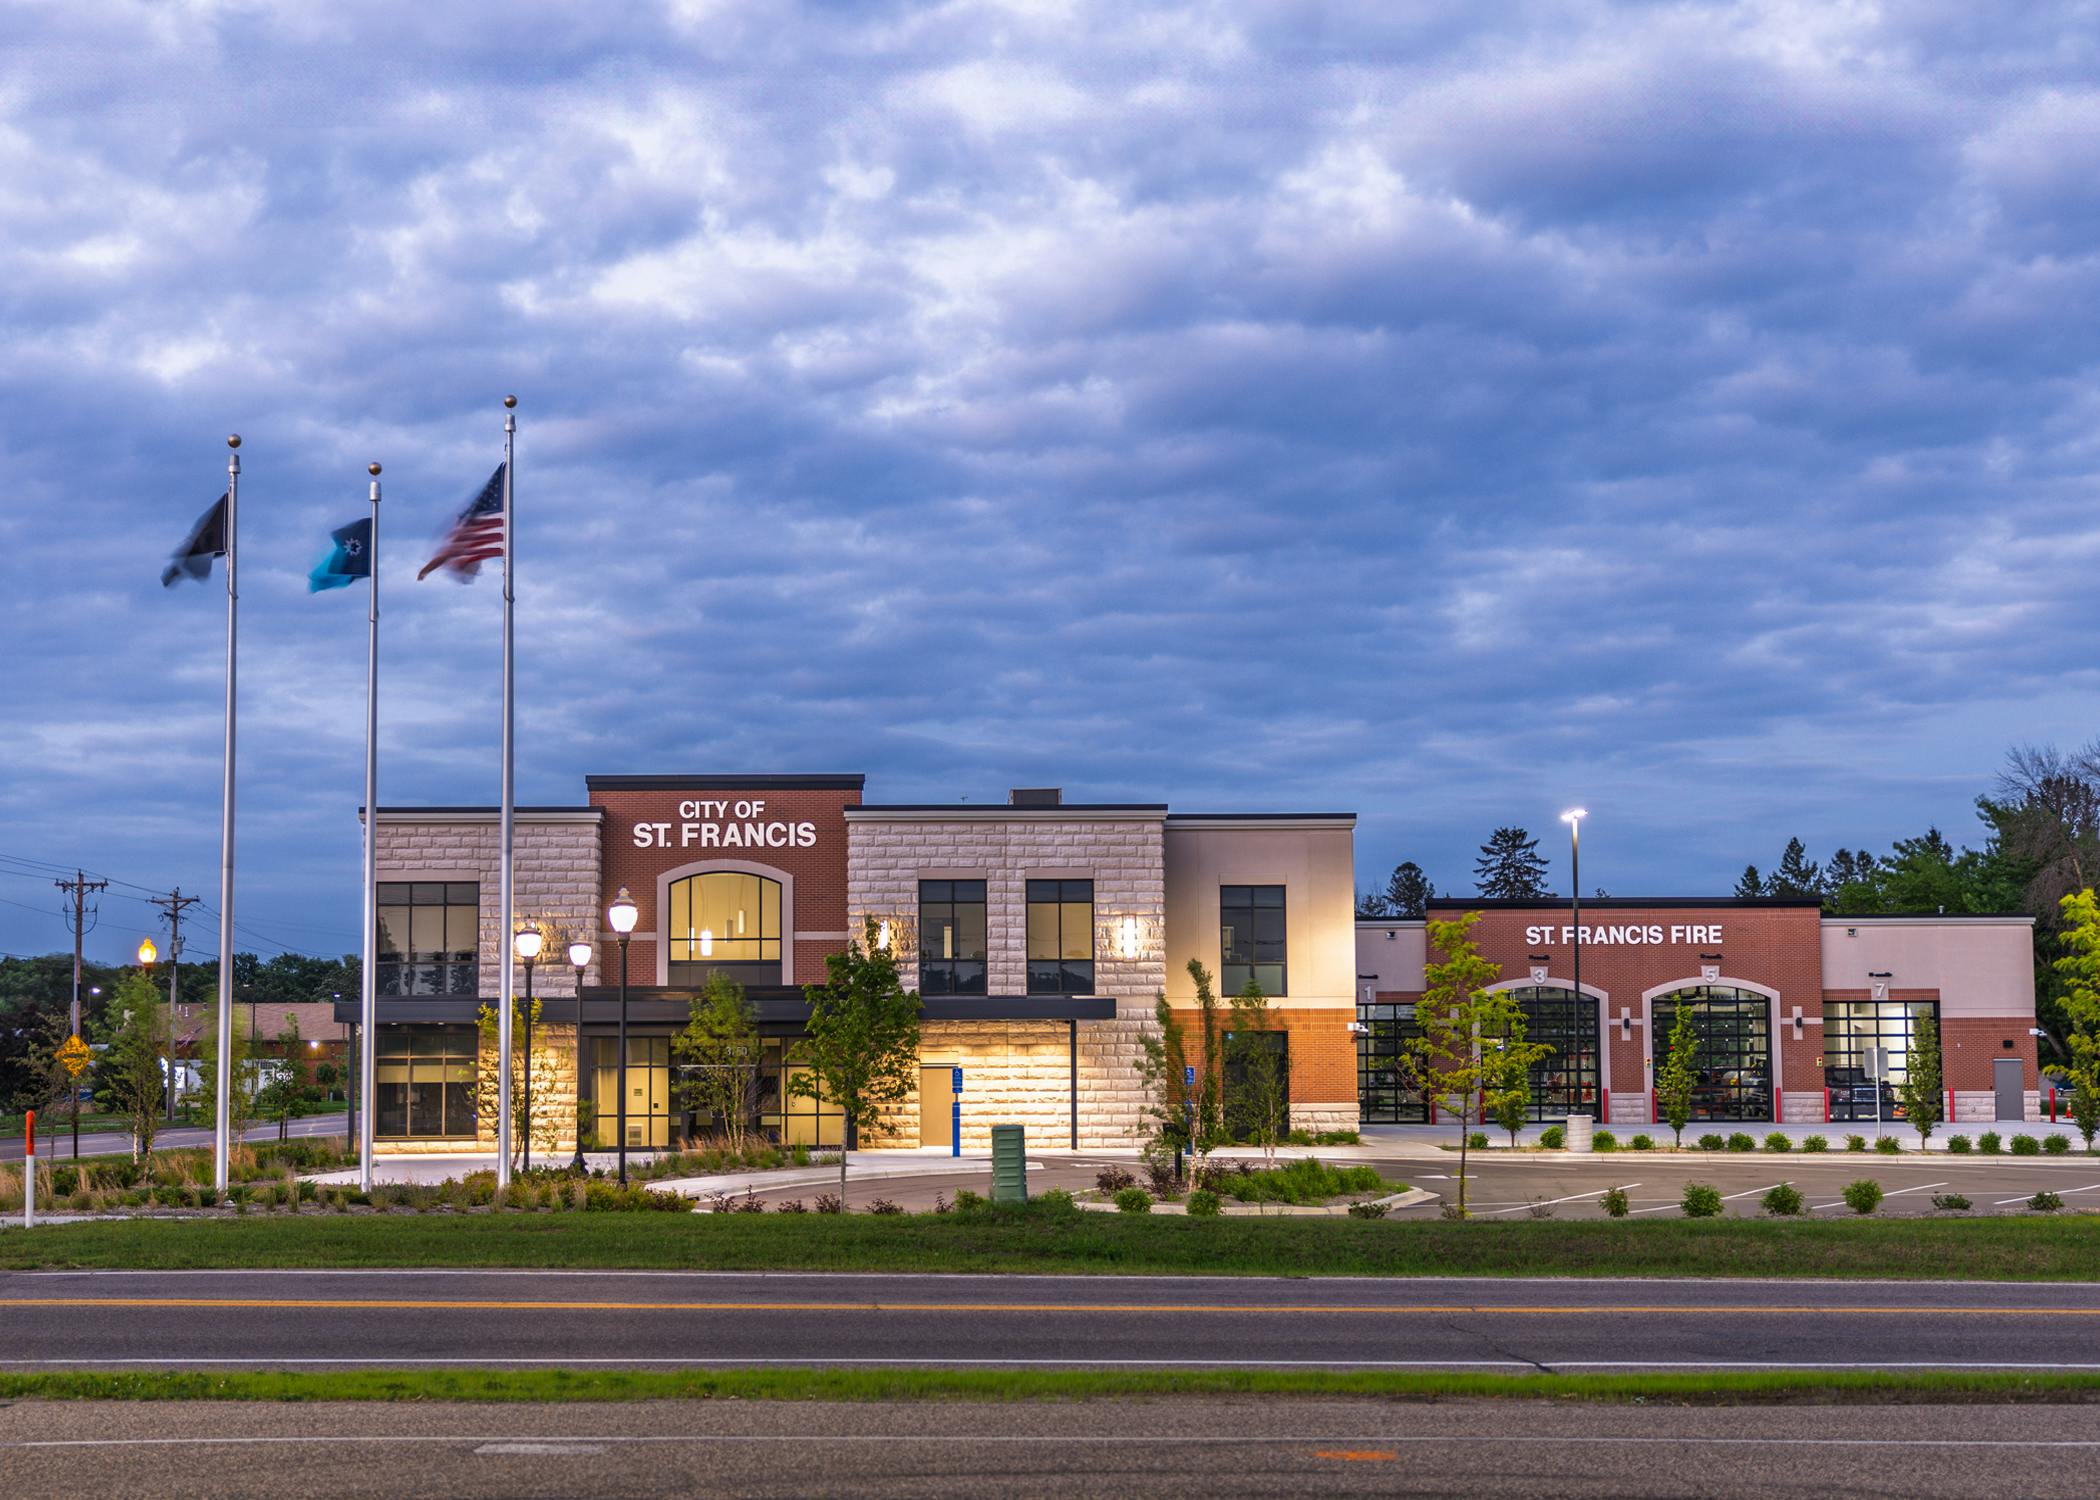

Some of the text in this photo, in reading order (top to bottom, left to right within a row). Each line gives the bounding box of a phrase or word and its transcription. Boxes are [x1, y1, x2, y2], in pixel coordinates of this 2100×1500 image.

[679, 801, 765, 819] CITY OF
[633, 822, 817, 848] ST. FRANCIS
[1526, 925, 1723, 945] ST. FRANCIS FIRE
[1534, 969, 1545, 984] 3
[1705, 968, 1717, 983] 5
[1364, 985, 1371, 1000] 1
[1875, 983, 1886, 997] 7
